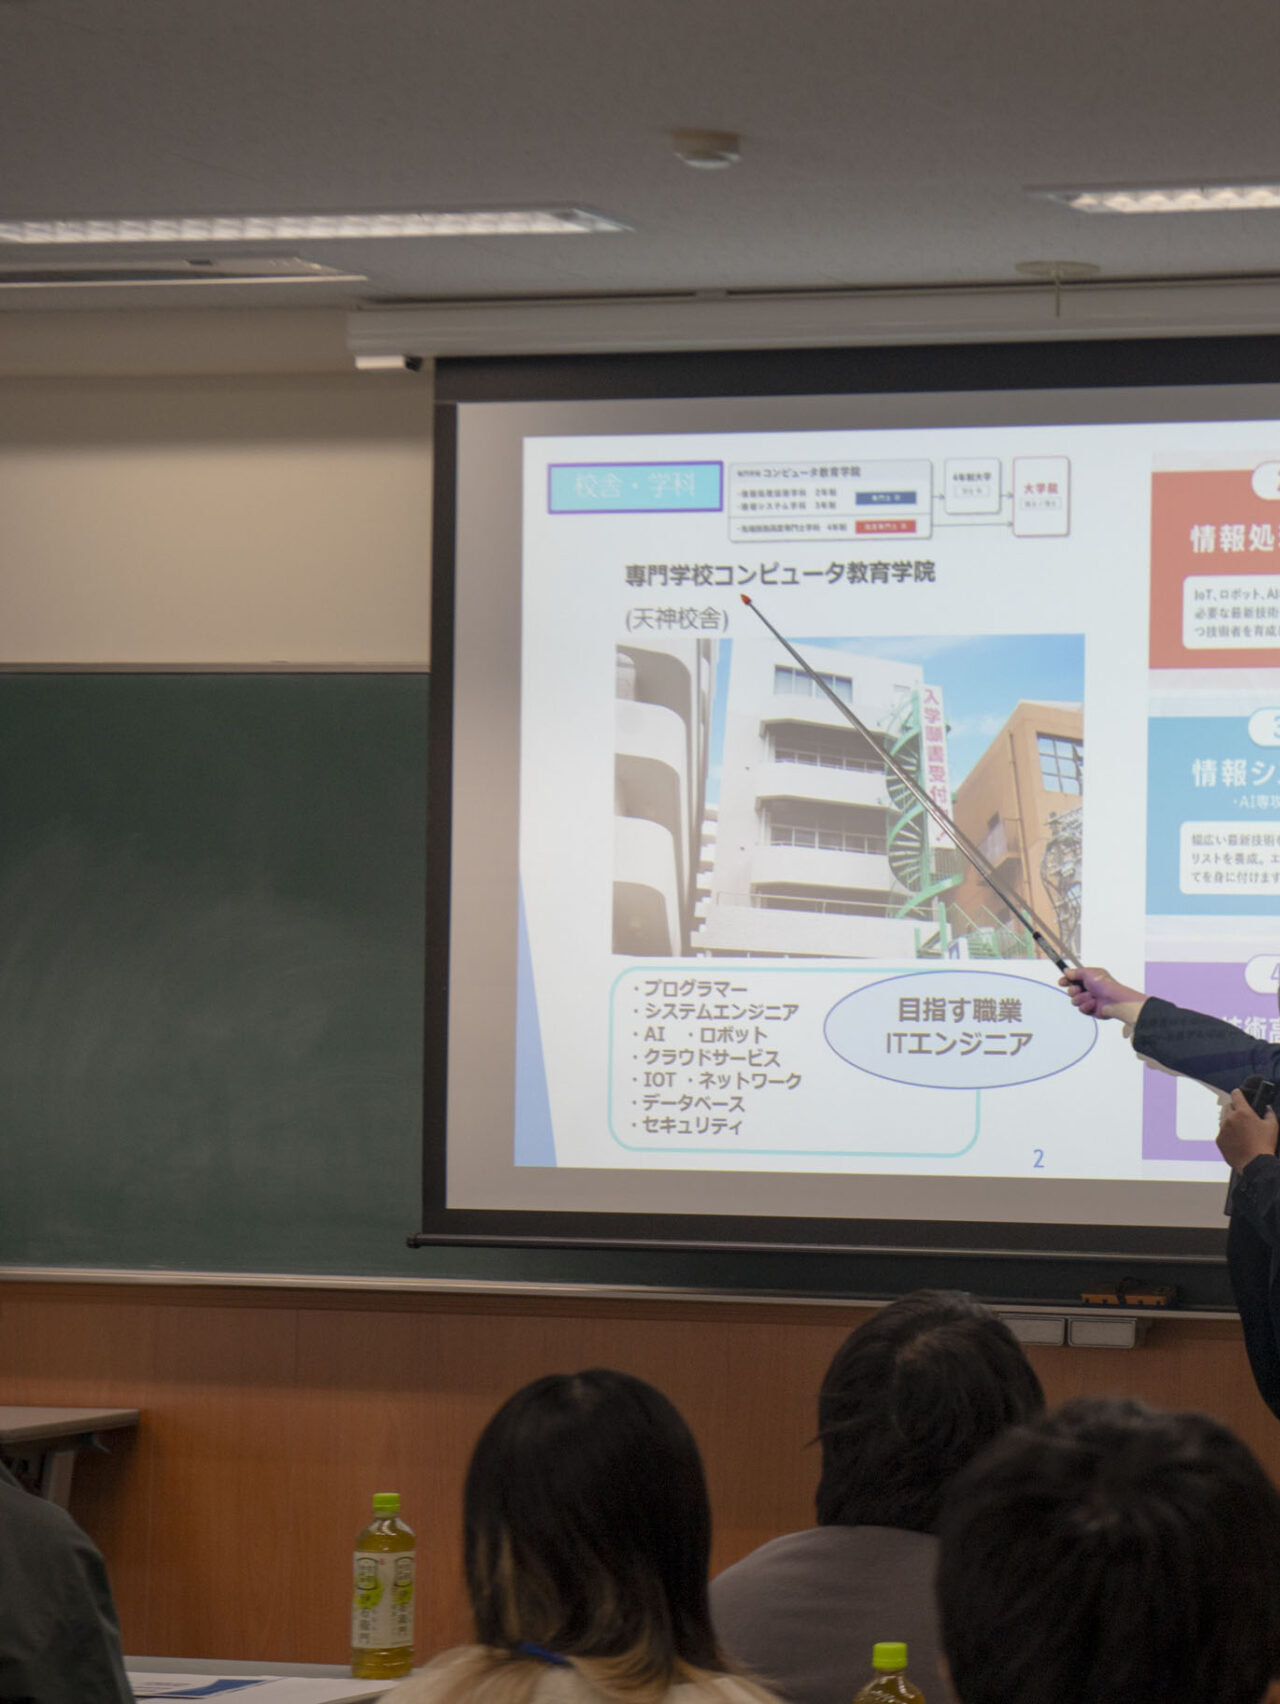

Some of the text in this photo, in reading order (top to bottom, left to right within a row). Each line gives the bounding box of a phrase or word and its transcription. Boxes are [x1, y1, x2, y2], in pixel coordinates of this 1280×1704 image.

[575, 472, 696, 499] 校舎・学科
[625, 561, 936, 588] 専門学校コンピュータ教育学院
[626, 607, 729, 632] (天神校舎)
[899, 997, 1023, 1024] 目指す職業
[887, 1031, 1033, 1056] ITエンジニア
[1032, 1149, 1045, 1169] 2
